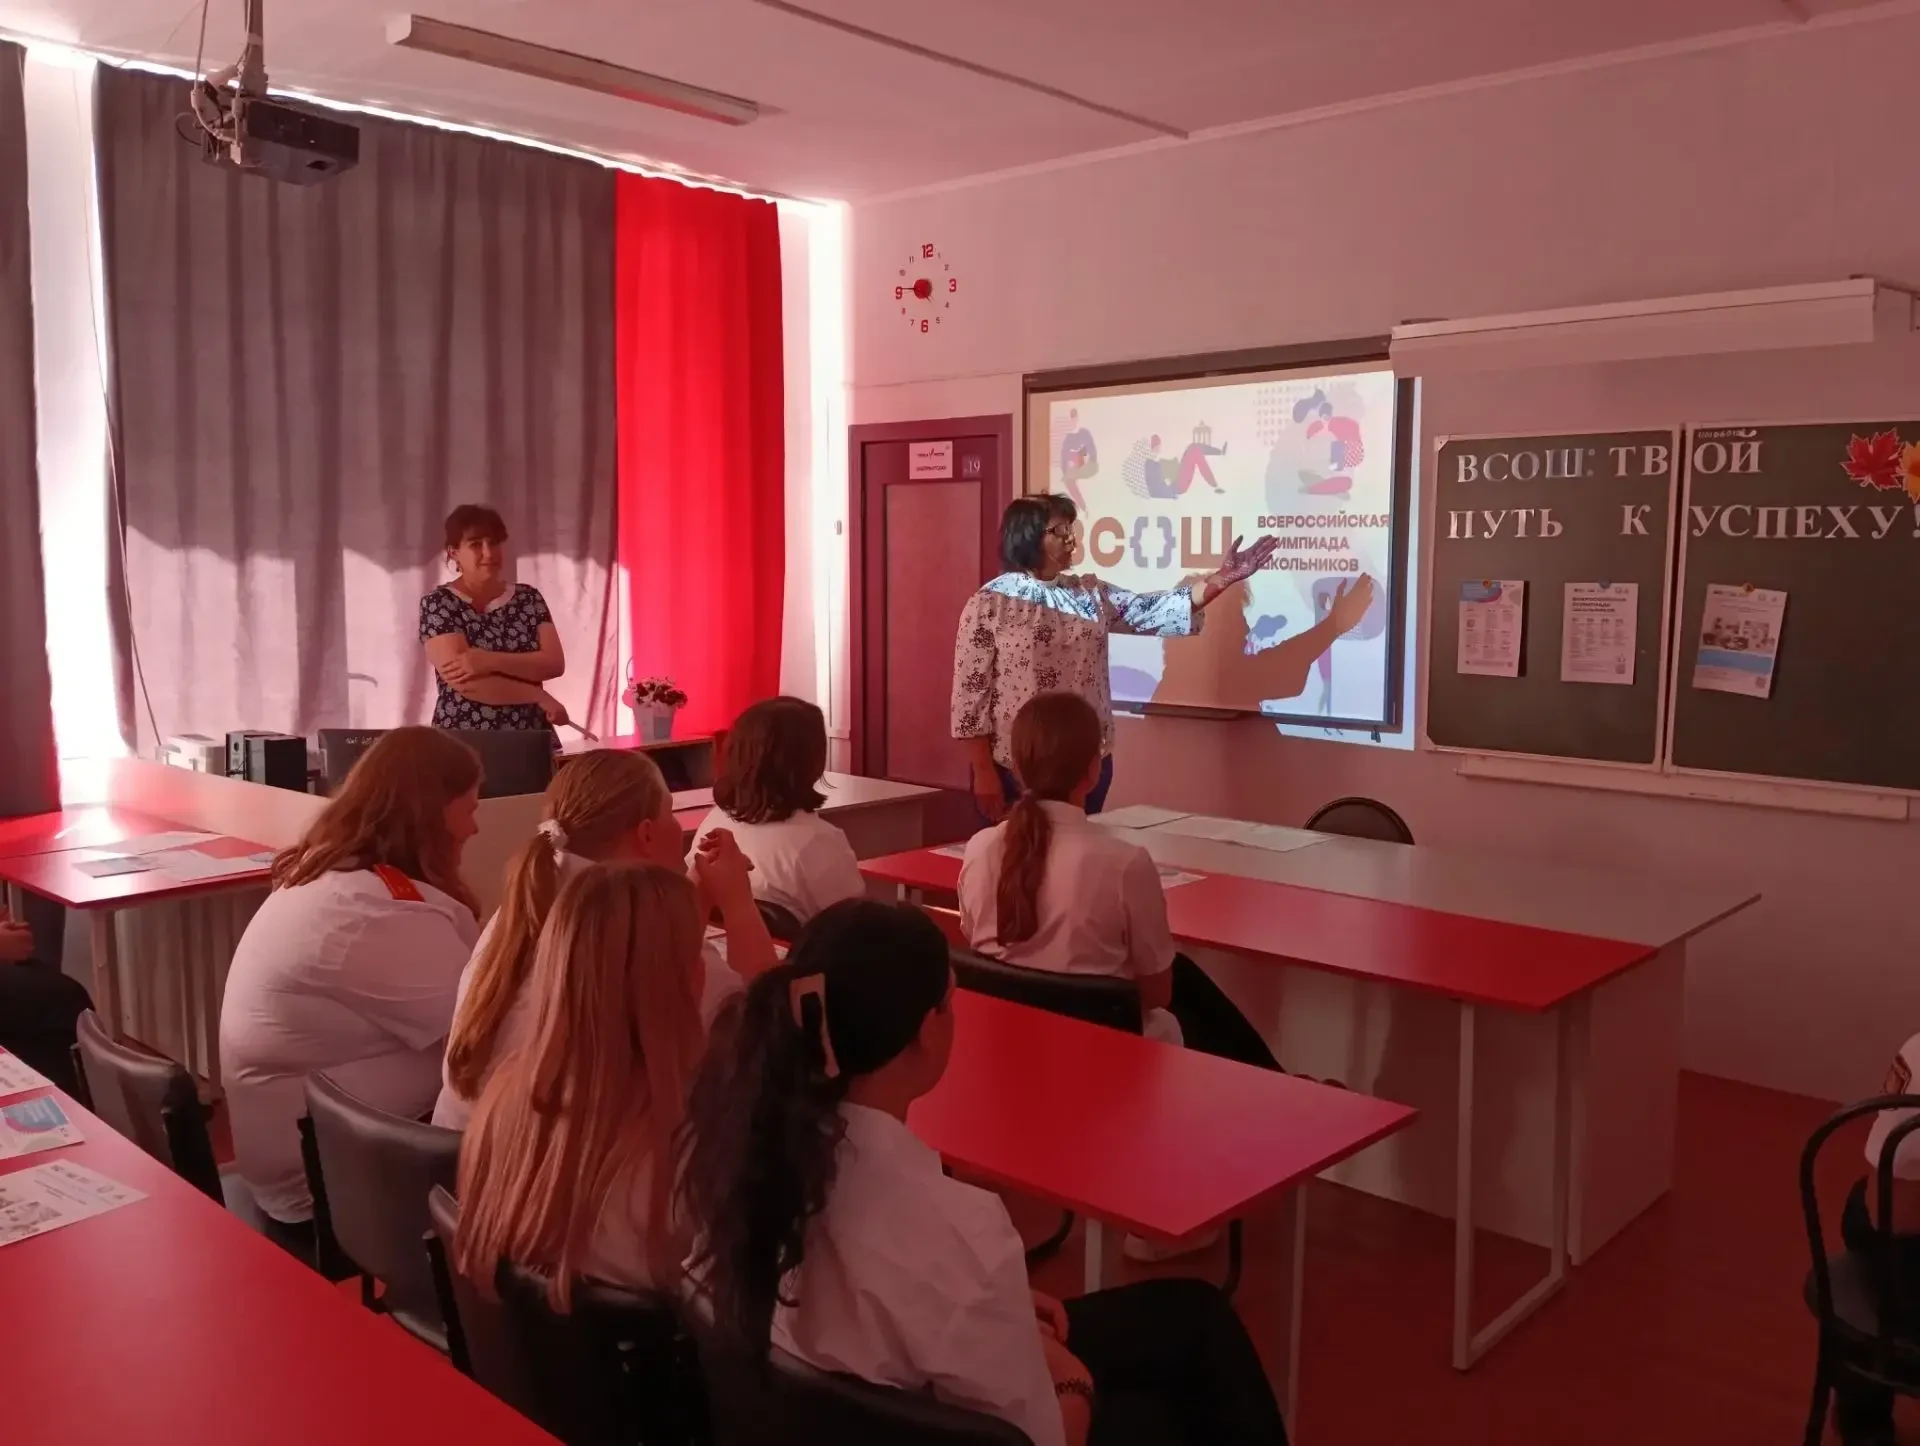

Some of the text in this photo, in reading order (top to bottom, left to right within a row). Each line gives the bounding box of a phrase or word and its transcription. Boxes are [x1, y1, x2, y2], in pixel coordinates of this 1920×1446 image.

[922, 243, 934, 259] 12
[895, 286, 903, 300] 9
[949, 278, 957, 293] 3
[921, 319, 929, 333] 6
[1456, 448, 1595, 483] ВСОШ:
[1257, 510, 1390, 528] ВСЕРОССИЙСКАЯ
[1446, 508, 1563, 539] ПУТЬ
[1619, 504, 1651, 535] К
[1275, 536, 1350, 552] ИМПИАДА
